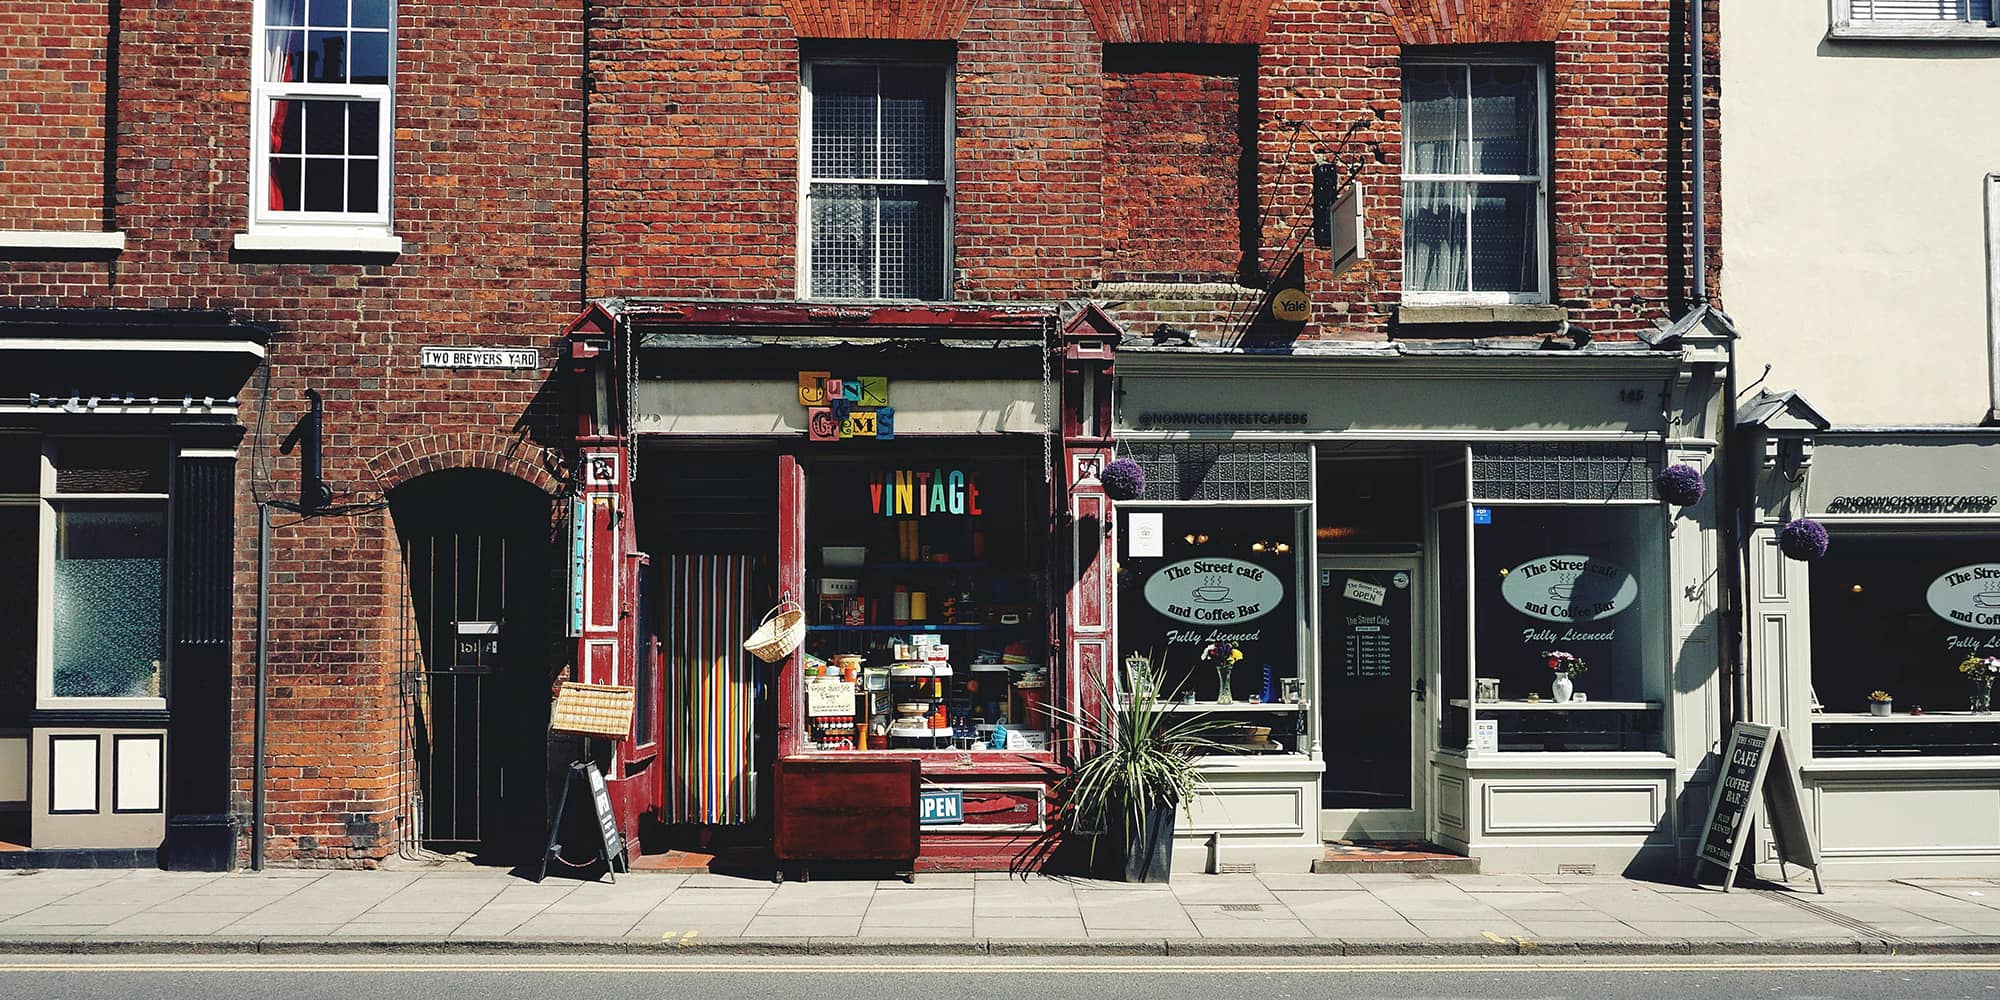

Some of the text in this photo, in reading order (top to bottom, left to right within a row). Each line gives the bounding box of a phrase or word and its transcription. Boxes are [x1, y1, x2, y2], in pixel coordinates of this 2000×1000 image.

[1281, 300, 1306, 312] Yale
[425, 352, 534, 365] TWO BREWERS YARD
[870, 468, 982, 517] VINTAGE
[1164, 560, 1265, 582] The Street café
[1521, 563, 1547, 579] The
[1549, 559, 1588, 571] Street
[1945, 572, 1972, 588] The
[1352, 589, 1377, 601] OPEN
[1167, 602, 1260, 621] and Coffee Bar
[1524, 600, 1616, 618] and Coffee Bar
[1950, 609, 1973, 623] and
[1166, 628, 1261, 645] Fully Licenced
[1523, 628, 1615, 644] Fully Licenced
[1946, 635, 1981, 651] Fully
[460, 642, 477, 653] 151
[1733, 749, 1760, 768] CAFÉ
[1725, 775, 1752, 792] COFFEE
[1725, 790, 1741, 805] BAR
